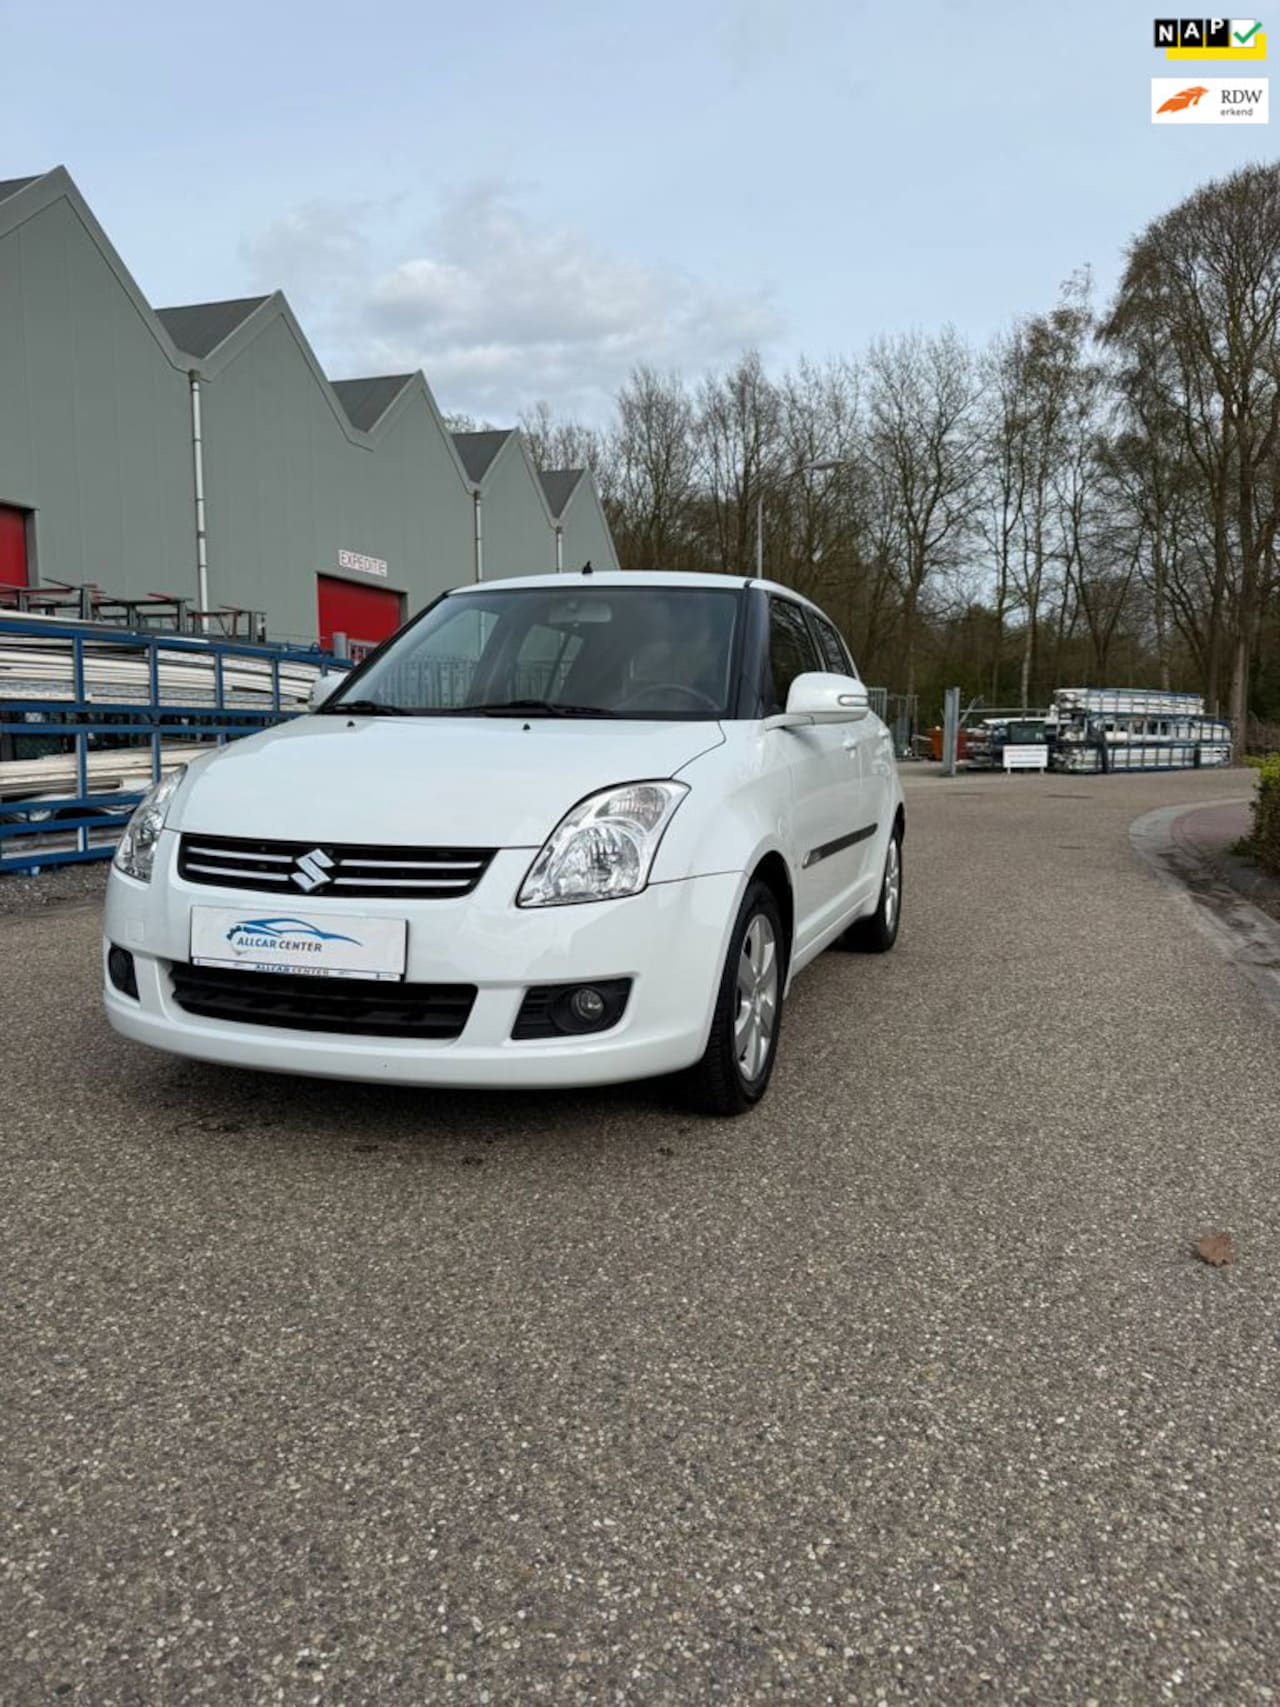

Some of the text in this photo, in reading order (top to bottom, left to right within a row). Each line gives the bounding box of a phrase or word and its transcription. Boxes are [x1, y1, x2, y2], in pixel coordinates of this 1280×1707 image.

[341, 551, 385, 574] EXPEDITIE
[237, 937, 322, 952] ALLCAR CENTER
